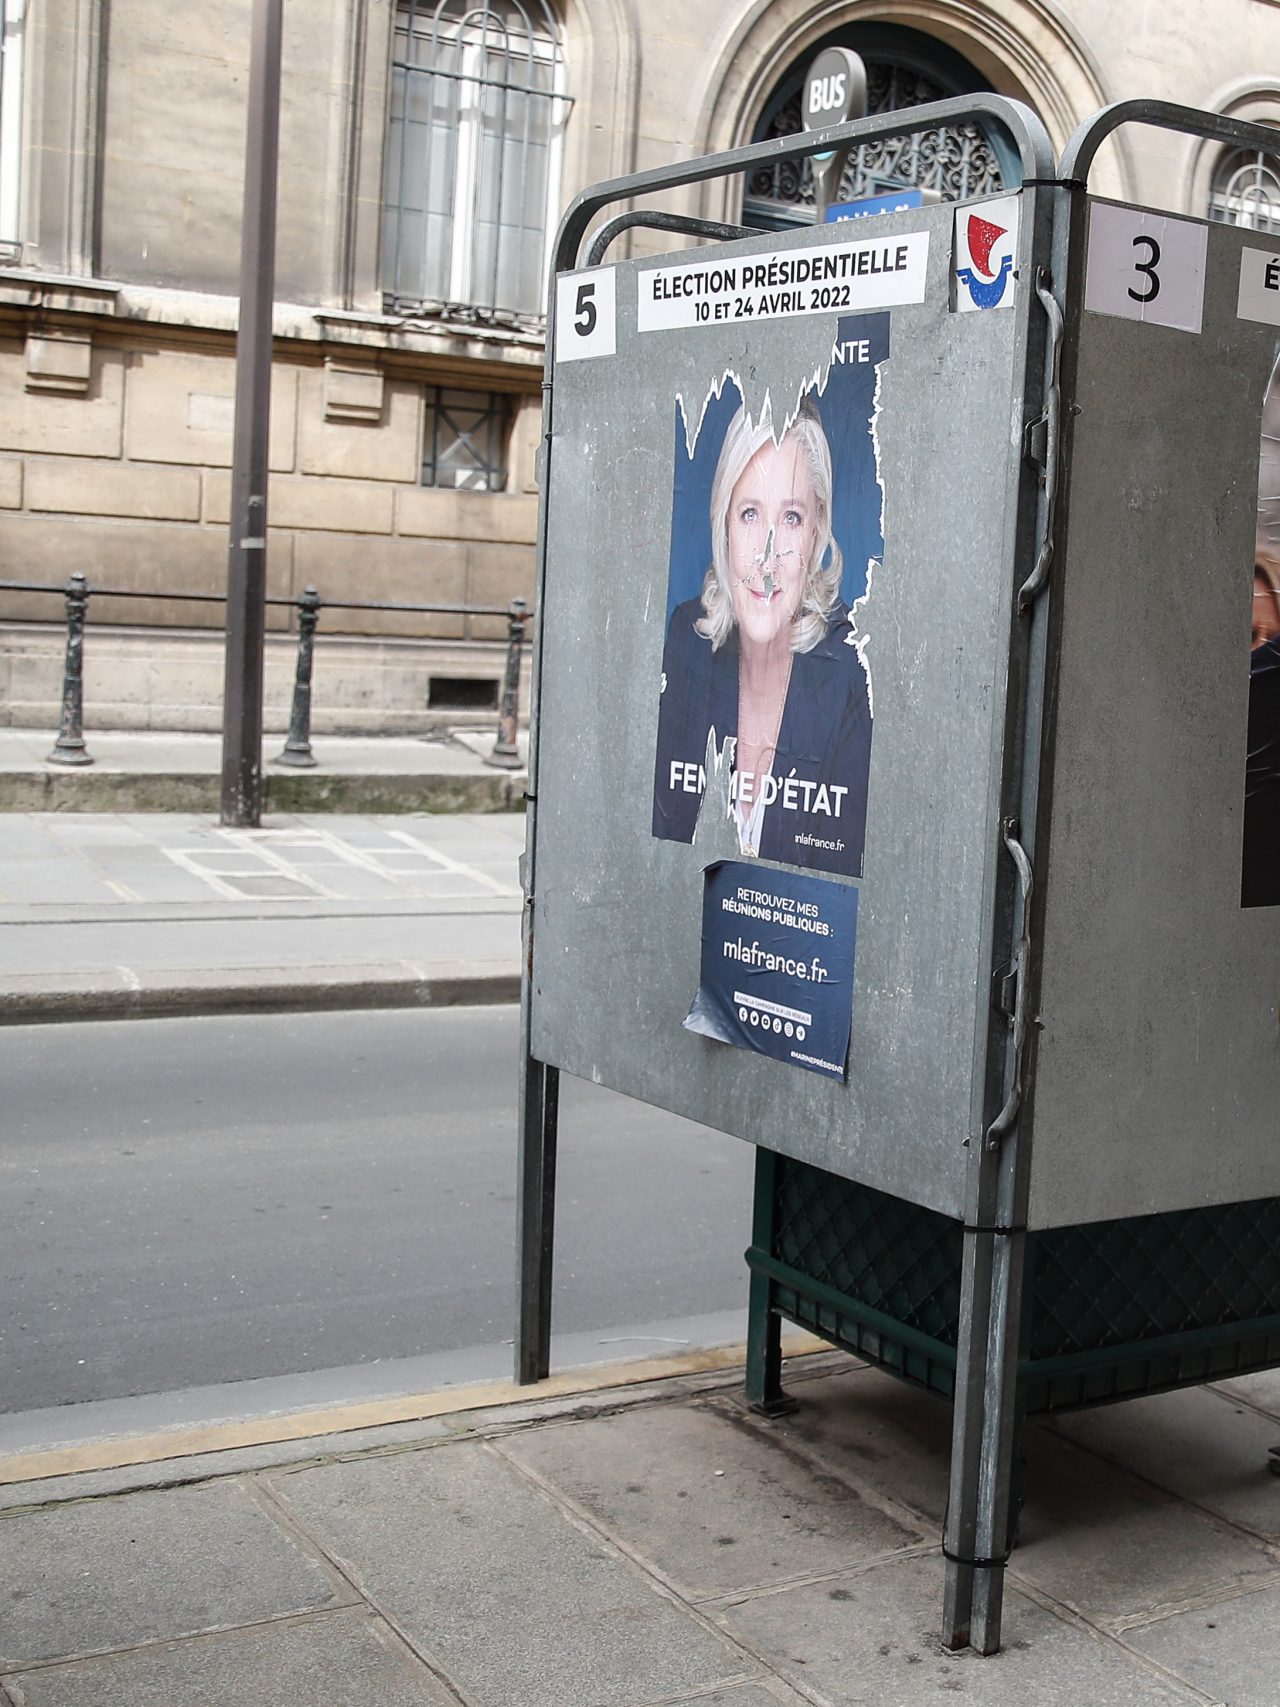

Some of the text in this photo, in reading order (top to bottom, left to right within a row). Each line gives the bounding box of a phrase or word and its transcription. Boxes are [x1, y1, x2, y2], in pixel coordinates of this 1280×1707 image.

[808, 73, 846, 113] BUS
[652, 246, 909, 301] ÉLECTION PRÉSIDENTIELLE
[1126, 235, 1161, 303] 3
[574, 283, 597, 337] 5
[695, 285, 851, 322] 10 ET 24 AVRIL 2022
[760, 768, 849, 818] D'ÉTAT
[722, 897, 772, 922] RÉUNIONS
[772, 912, 829, 936] PUBLIQUES
[737, 887, 819, 918] RETROUVEZ MES
[723, 937, 828, 984] mlafrance.fr
